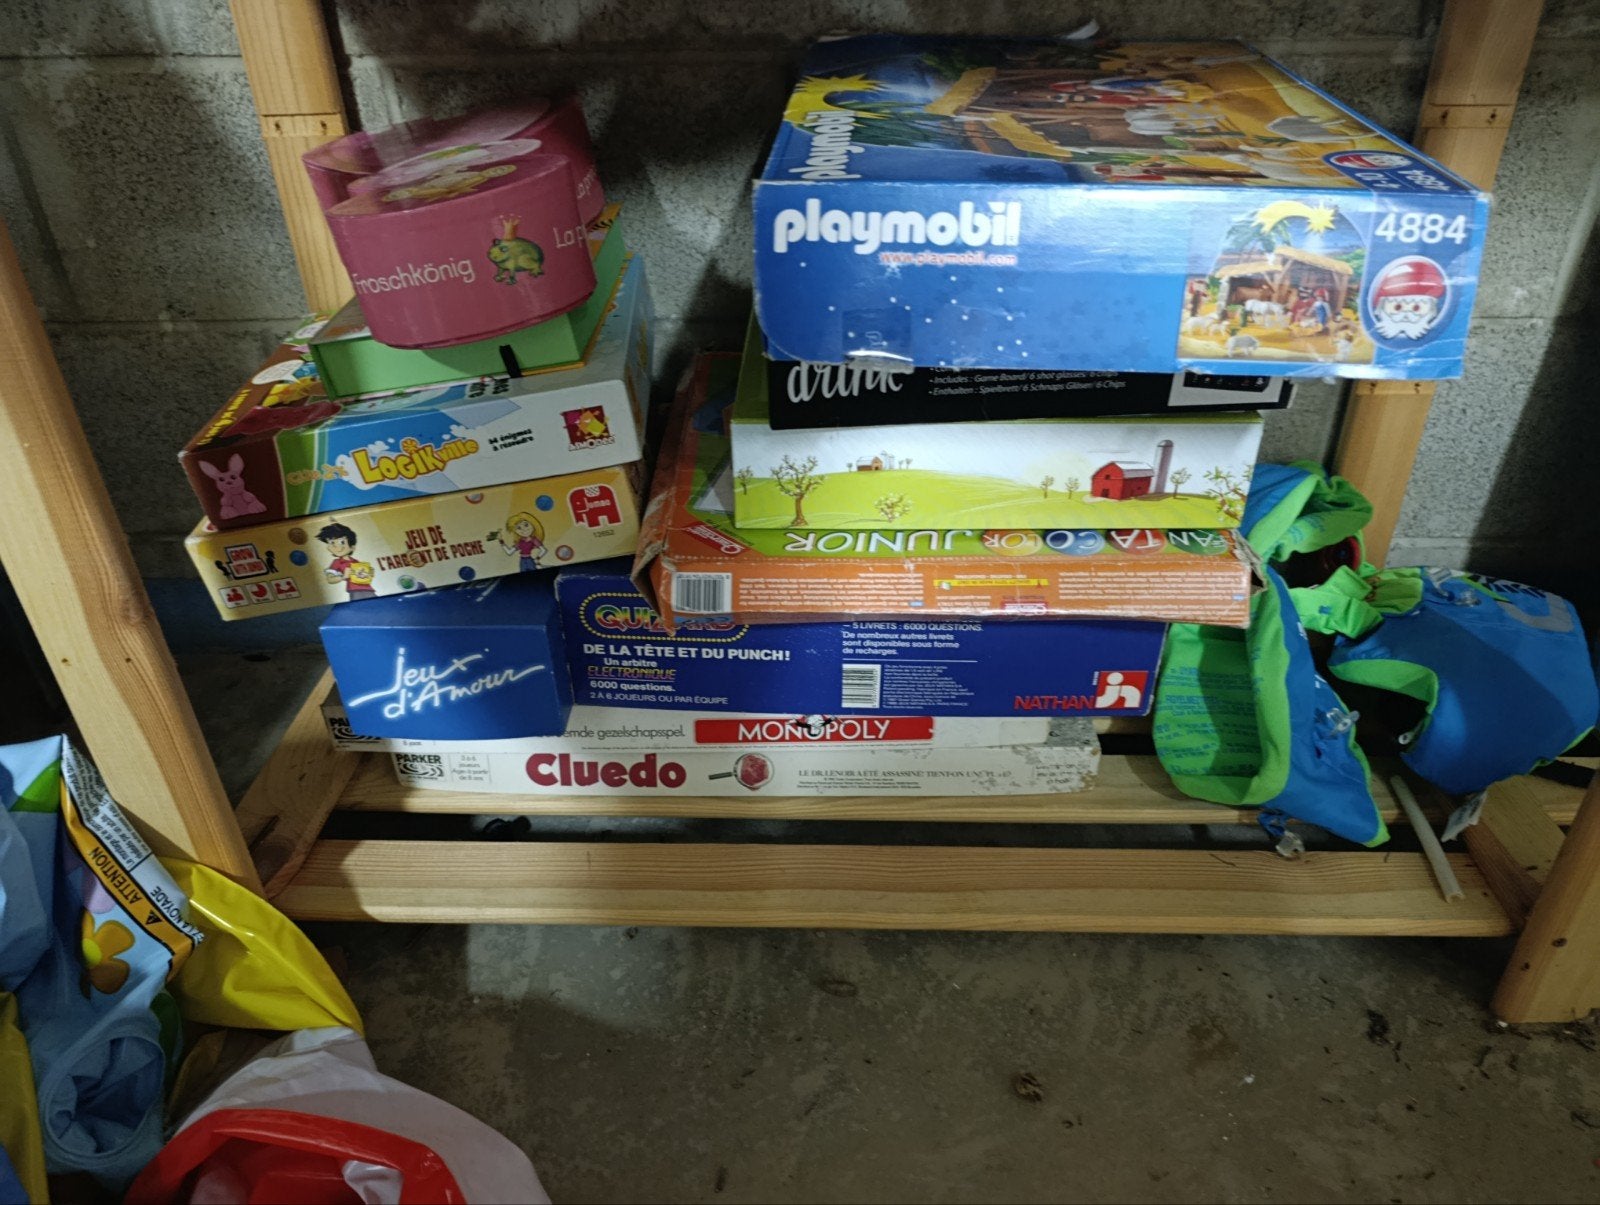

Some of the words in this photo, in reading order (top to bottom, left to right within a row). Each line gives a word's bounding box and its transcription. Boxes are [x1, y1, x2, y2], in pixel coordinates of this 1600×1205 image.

[787, 110, 866, 180] playmobil
[773, 198, 1022, 255] playmobil
[1374, 212, 1467, 245] 4884
[879, 250, 1018, 267] www.playmobil.com
[405, 528, 428, 550] JEU
[428, 525, 447, 545] DE
[784, 529, 974, 553] JUNIOR
[377, 549, 434, 571] L'ARGNT
[434, 546, 450, 561] DE
[450, 540, 486, 558] POCHE
[859, 622, 897, 630] LIVRETS
[903, 623, 926, 631] 6000
[842, 631, 855, 639] De
[857, 632, 899, 640] nombreux
[929, 633, 954, 641] livrets
[583, 644, 604, 654] DE
[610, 645, 631, 656] LA
[634, 644, 675, 658] TÊTE
[678, 647, 698, 658] ET
[701, 648, 724, 659] DU
[842, 639, 862, 647] sont
[863, 639, 911, 649] disponibles
[933, 641, 960, 649] forme
[855, 648, 898, 656] recharges.
[604, 657, 619, 666] Un
[621, 658, 657, 668] arbitre
[590, 680, 618, 690] 6000
[620, 681, 676, 692] questions.
[590, 691, 596, 699] 2
[613, 693, 656, 702] JOUEURS
[658, 694, 673, 702] OU
[675, 695, 693, 703] PAR
[1014, 695, 1095, 710] NATHAN
[396, 753, 442, 764] PARKER
[526, 753, 687, 789] Cluedo
[88, 846, 143, 904] ATTENTION
